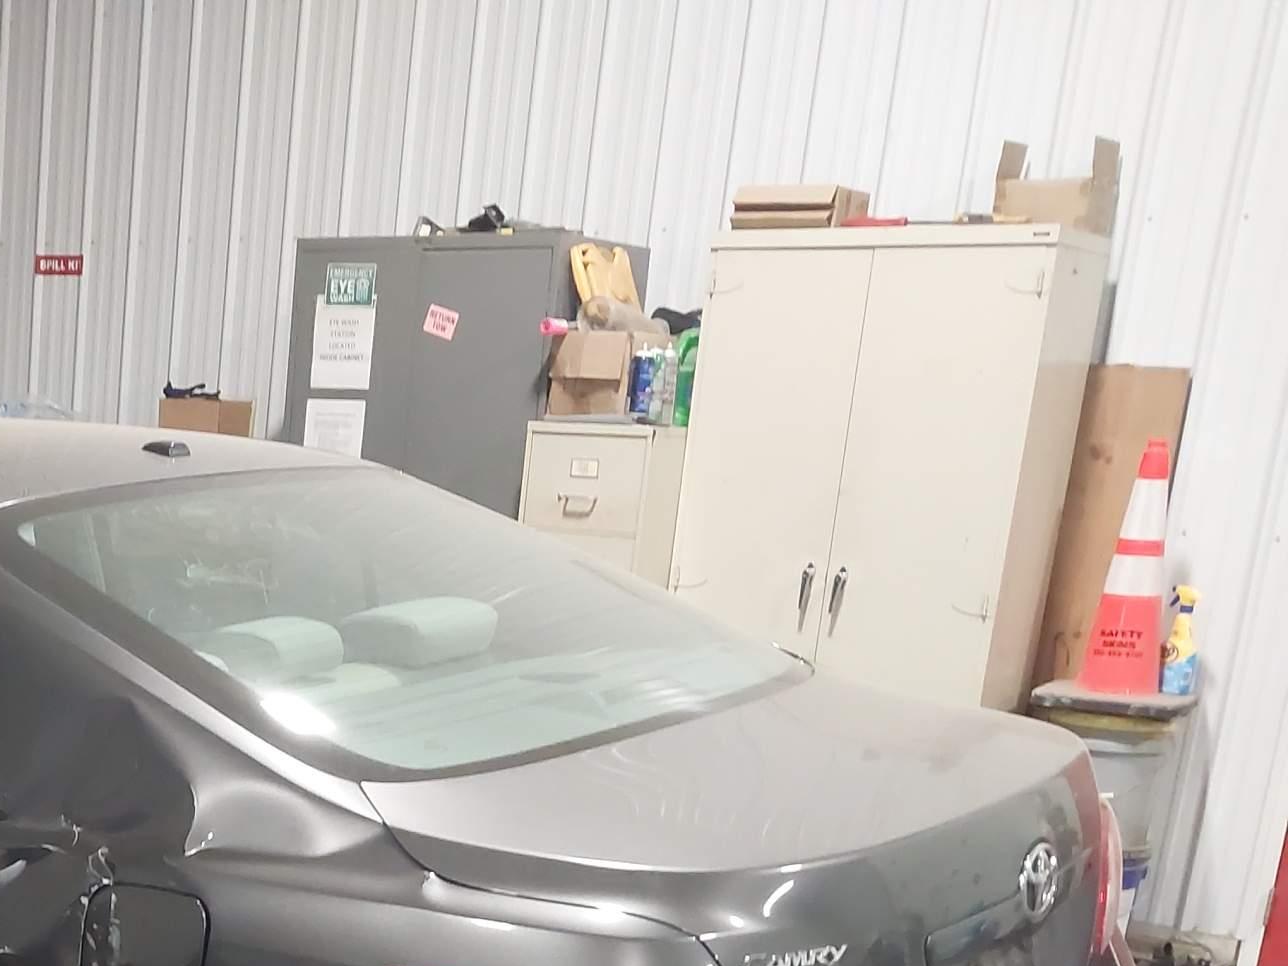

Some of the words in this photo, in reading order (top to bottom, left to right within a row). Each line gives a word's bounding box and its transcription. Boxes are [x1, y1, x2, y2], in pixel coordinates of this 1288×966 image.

[39, 258, 66, 271] SPILL
[330, 279, 355, 293] EYE
[329, 292, 355, 304] WASH
